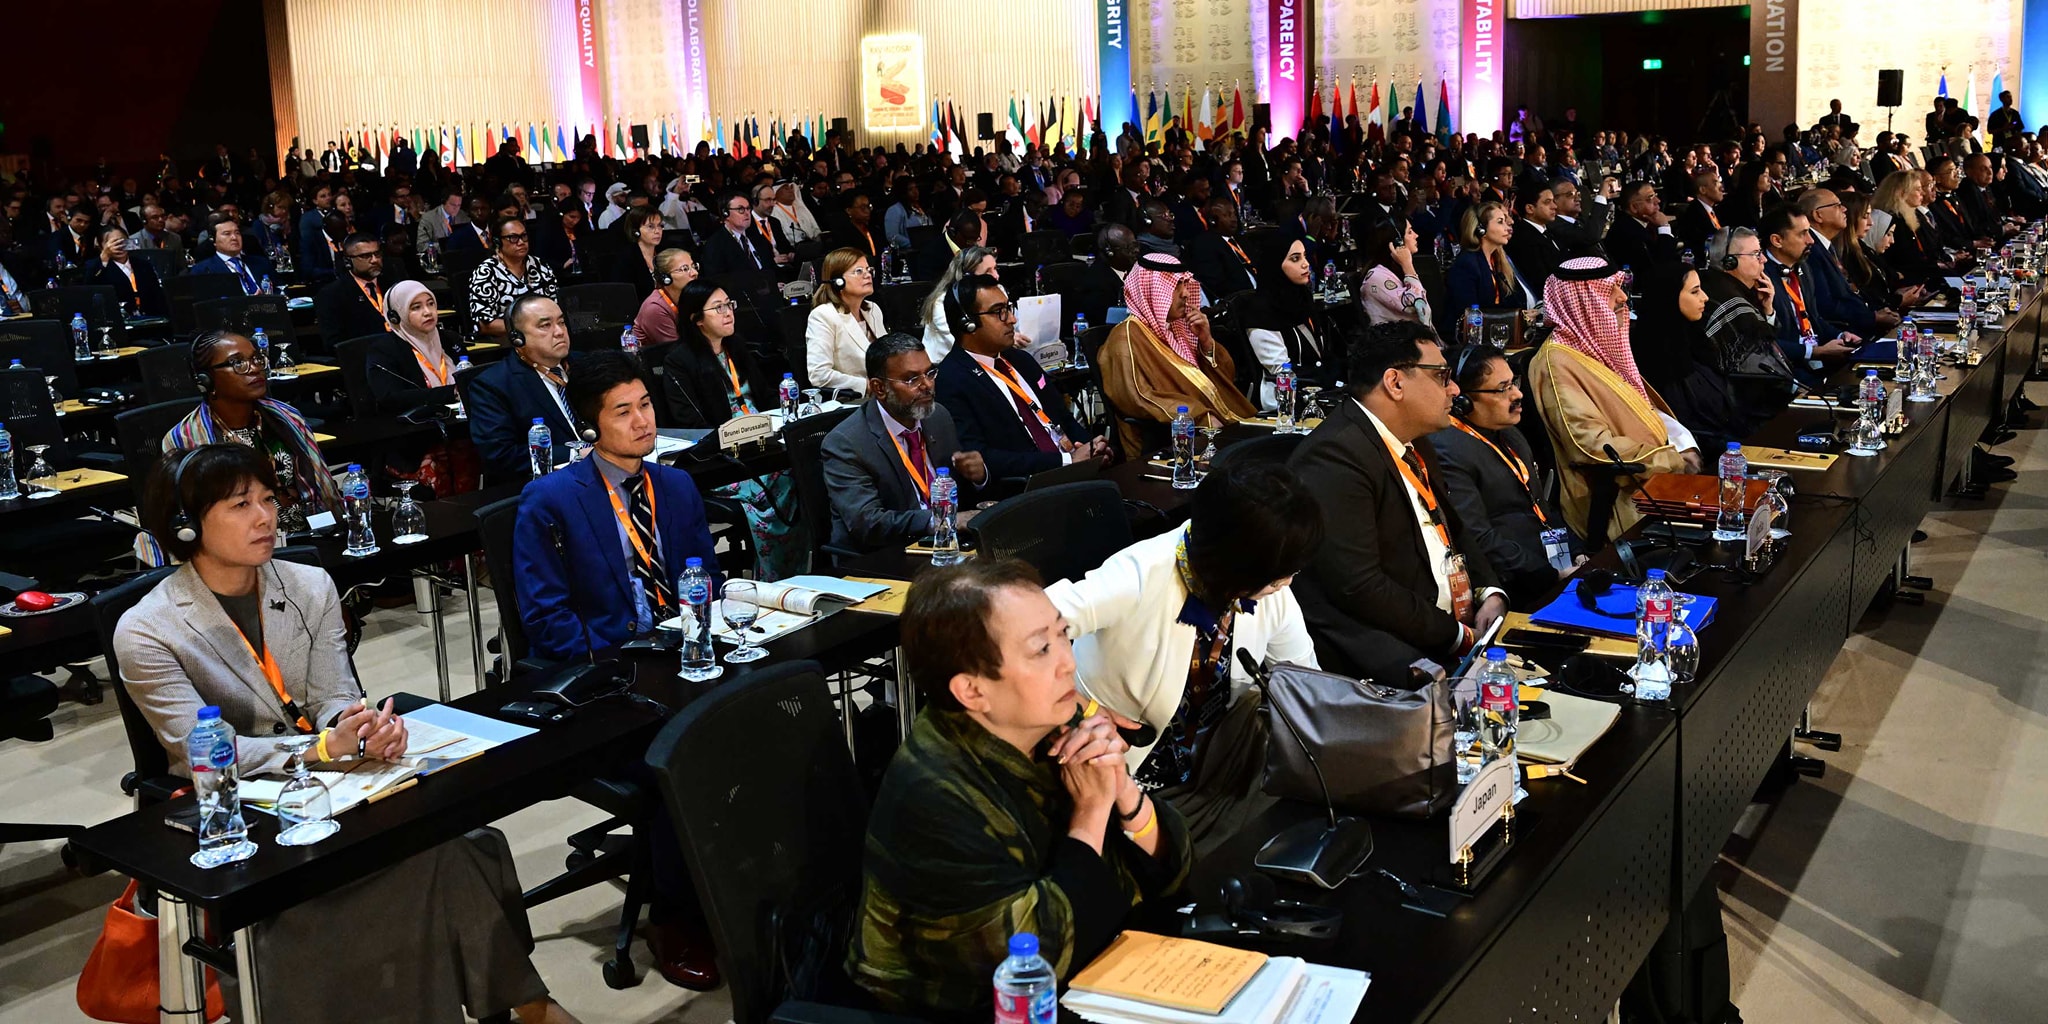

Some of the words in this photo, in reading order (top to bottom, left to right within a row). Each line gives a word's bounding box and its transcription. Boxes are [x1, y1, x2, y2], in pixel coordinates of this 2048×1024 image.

[580, 0, 594, 68] EQUALITY
[1041, 351, 1059, 359] Bulgaria
[724, 429, 740, 437] Brunei
[740, 422, 769, 433] Darussalam
[1473, 783, 1497, 814] Japan
